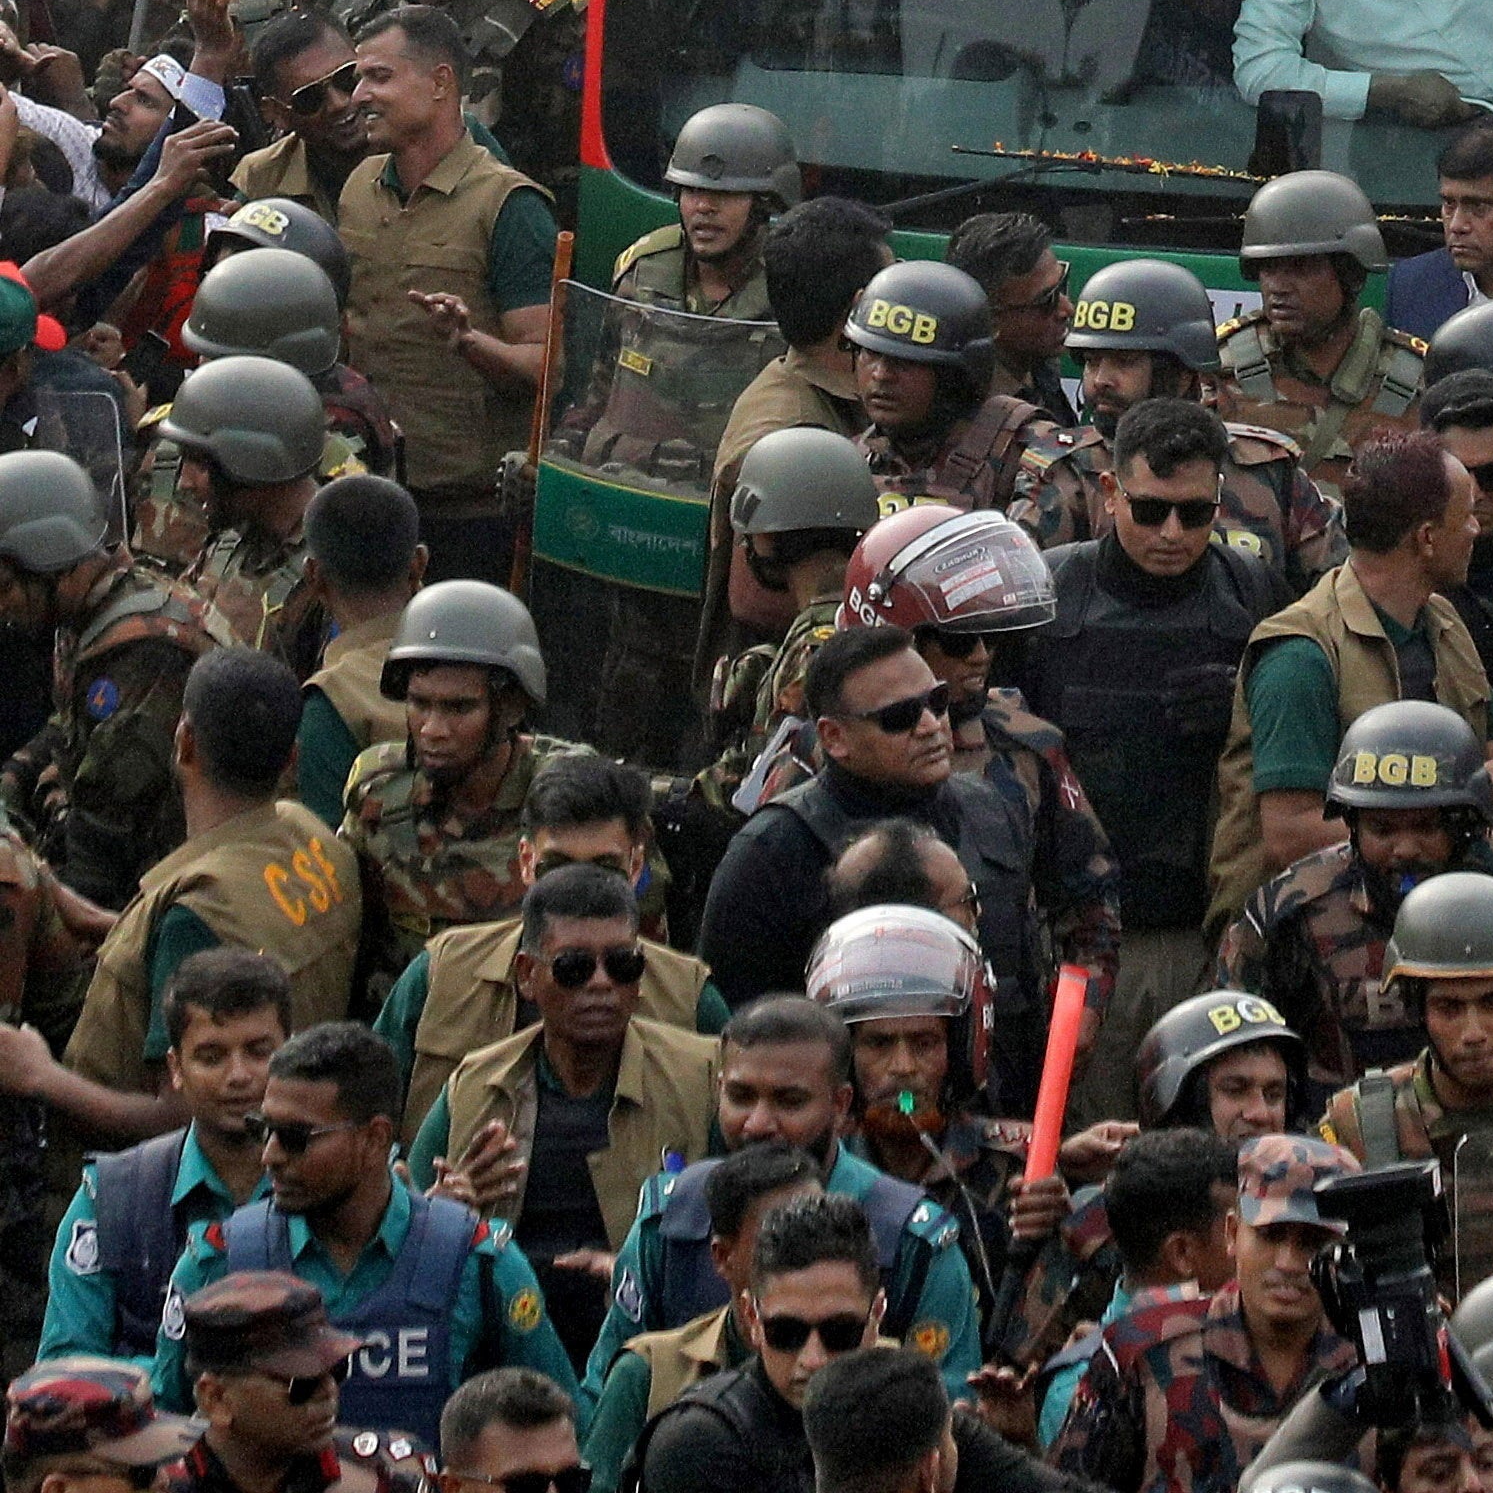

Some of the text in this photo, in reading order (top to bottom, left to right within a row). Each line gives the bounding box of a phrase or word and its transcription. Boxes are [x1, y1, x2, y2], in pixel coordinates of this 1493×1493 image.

[867, 298, 938, 344] BGB
[1073, 299, 1136, 331] BGB
[1353, 753, 1438, 787] BGB
